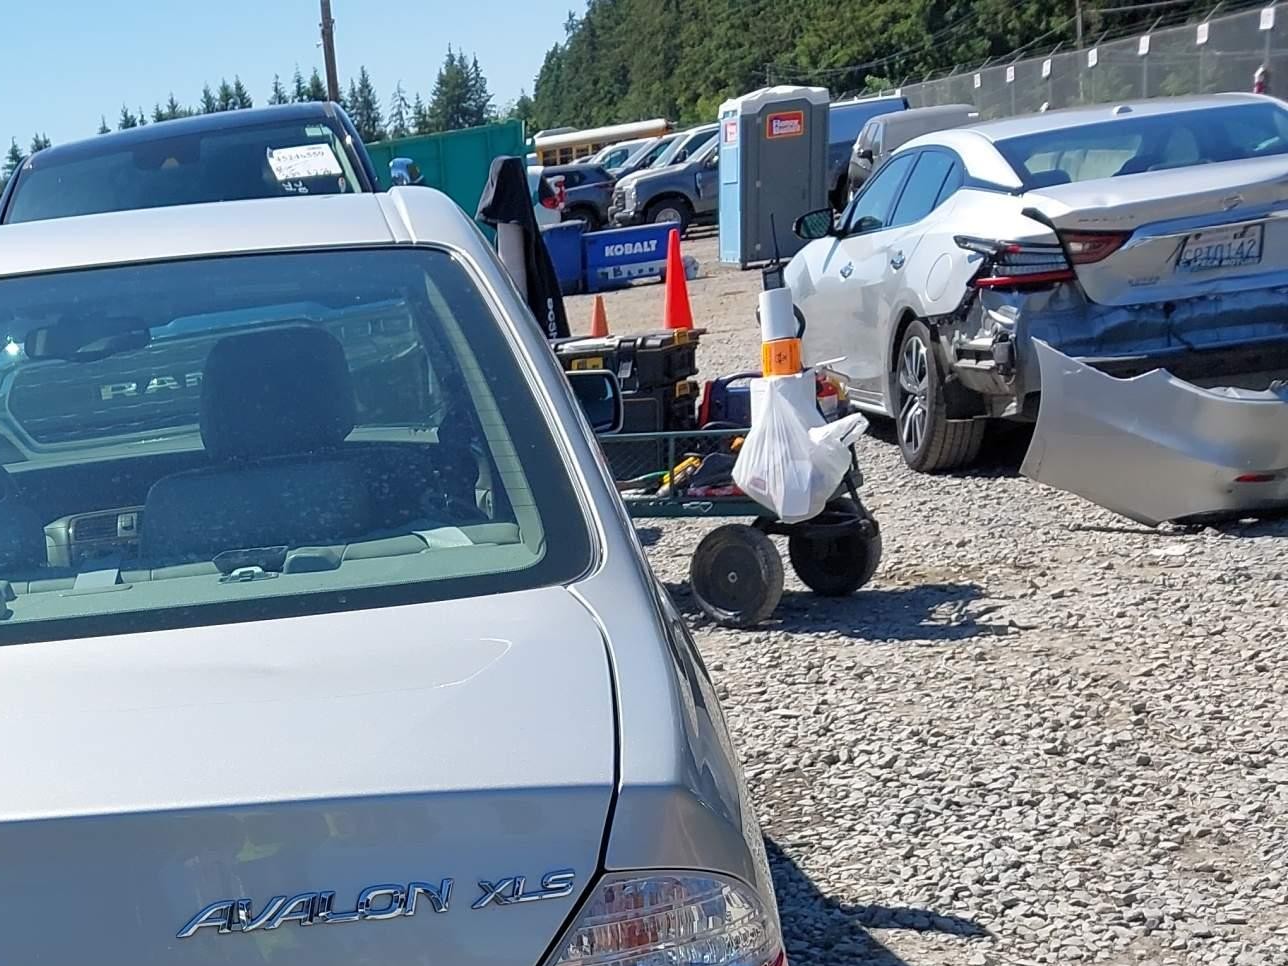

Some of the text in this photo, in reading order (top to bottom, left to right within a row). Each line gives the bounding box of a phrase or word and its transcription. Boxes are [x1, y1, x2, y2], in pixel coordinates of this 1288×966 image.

[604, 239, 658, 257] KOBALT
[175, 868, 576, 939] AVALON XLS
